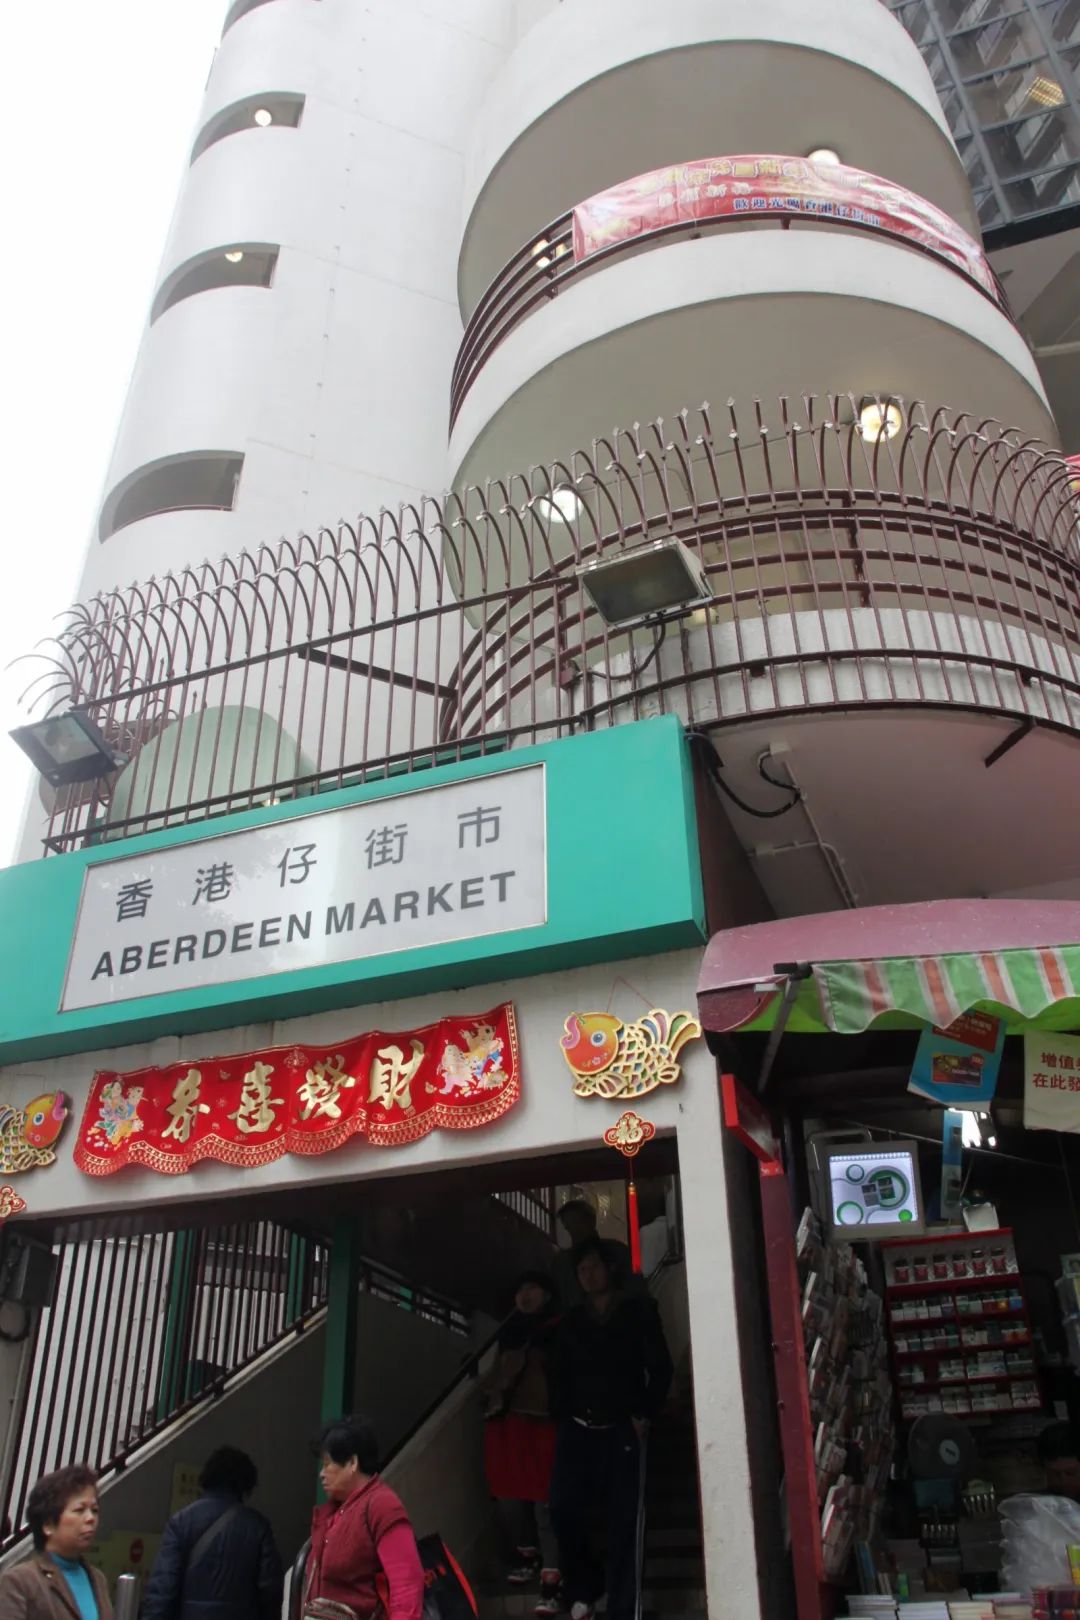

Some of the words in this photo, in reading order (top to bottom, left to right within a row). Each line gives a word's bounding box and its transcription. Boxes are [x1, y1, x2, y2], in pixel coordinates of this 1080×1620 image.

[116, 806, 502, 922] 香港仔街市
[91, 911, 311, 980] ABERDEEN
[325, 871, 517, 935] MARKET
[161, 1039, 425, 1143] 恭喜發財
[1040, 1052, 1080, 1071] 增值
